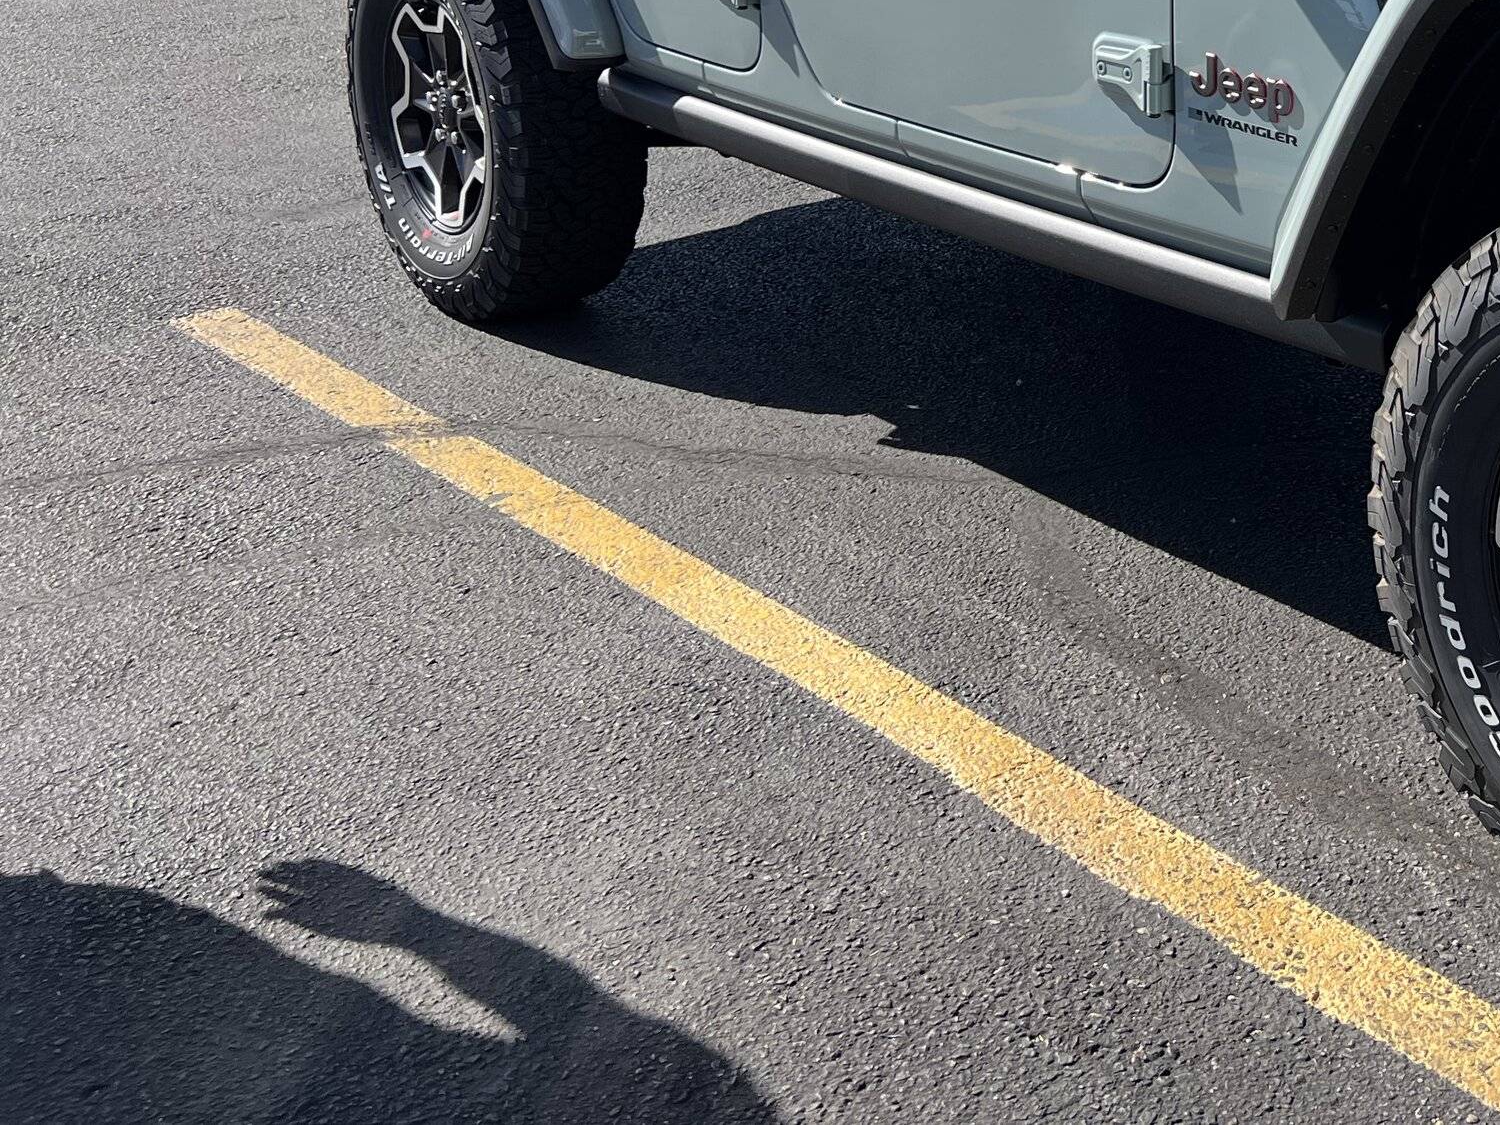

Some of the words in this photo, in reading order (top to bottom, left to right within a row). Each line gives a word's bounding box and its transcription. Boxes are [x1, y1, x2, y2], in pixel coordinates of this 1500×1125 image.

[1188, 52, 1295, 124] Jeep
[1203, 110, 1298, 147] WRANGLER
[374, 162, 397, 210] T/A
